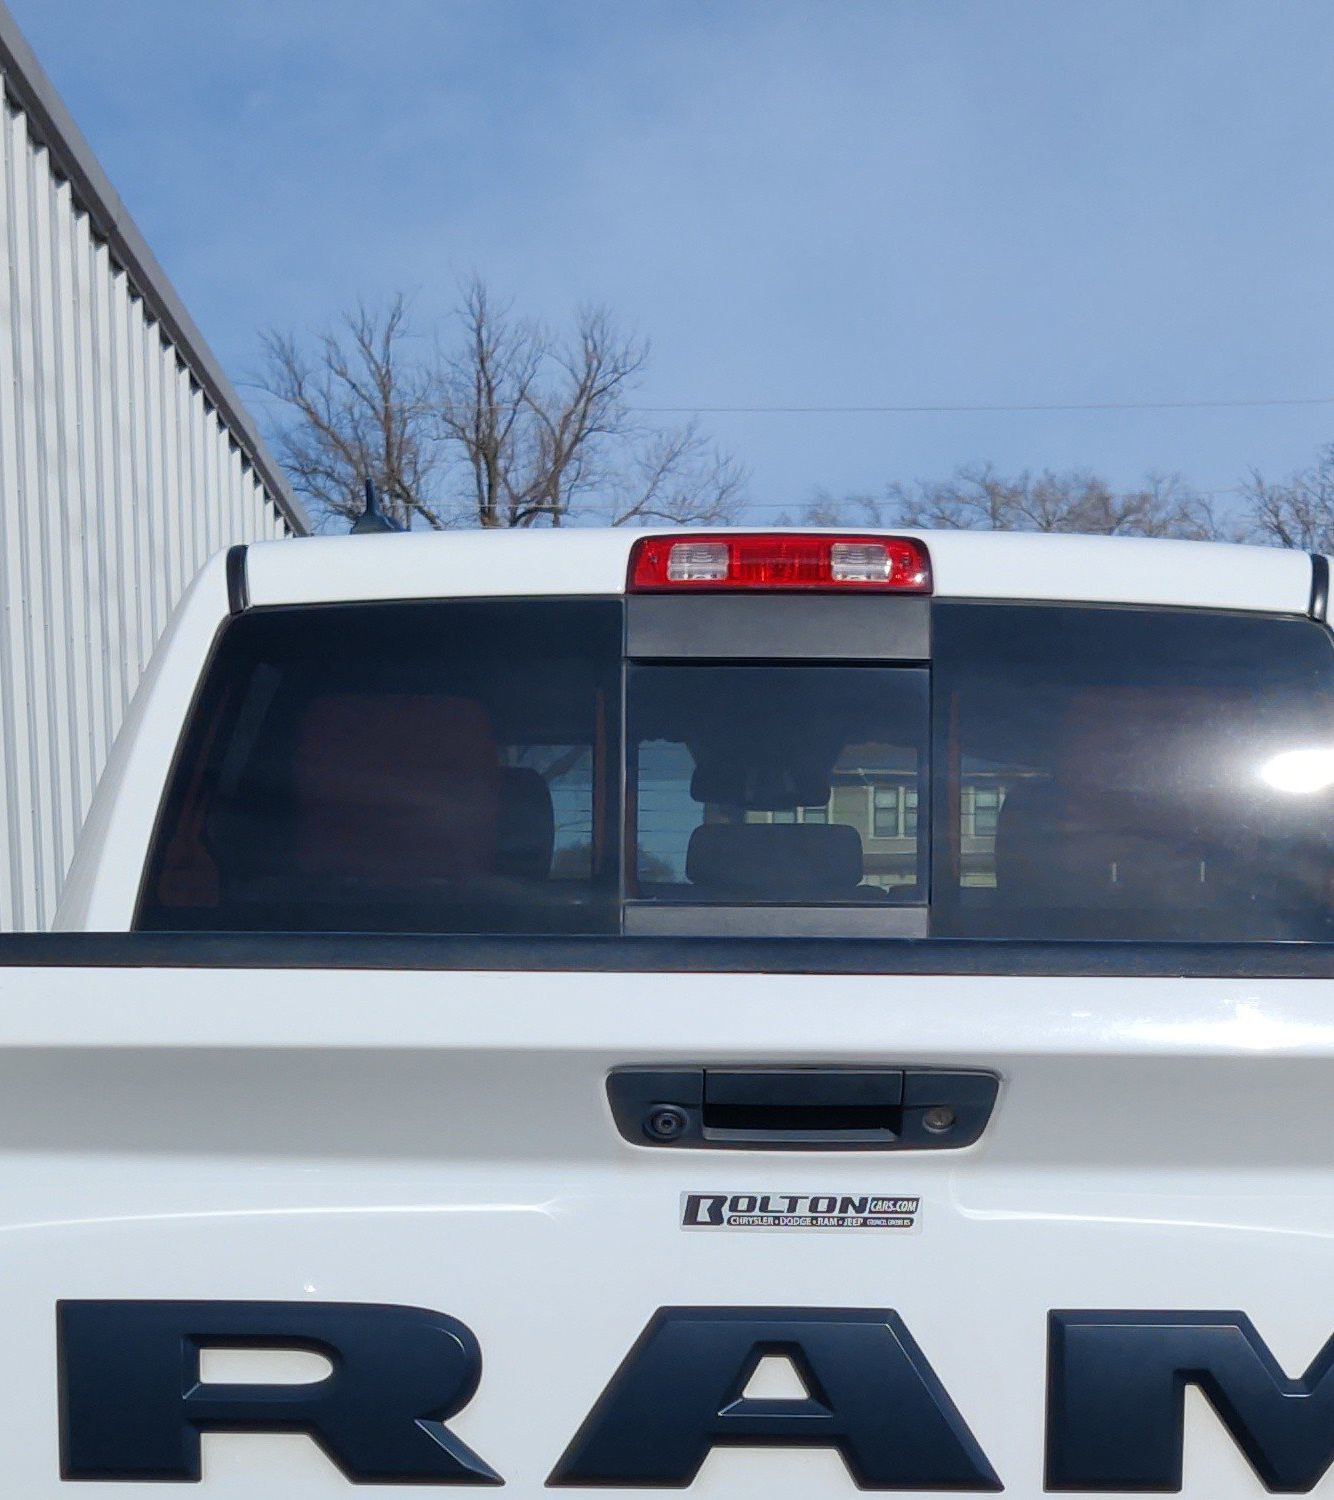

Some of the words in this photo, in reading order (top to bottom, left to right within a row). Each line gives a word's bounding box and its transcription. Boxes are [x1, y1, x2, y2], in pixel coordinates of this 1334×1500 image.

[730, 1216, 774, 1227] CHRYSLER
[779, 1216, 813, 1227] DODGE
[817, 1217, 838, 1227] RAM
[844, 1217, 864, 1227] JEEP
